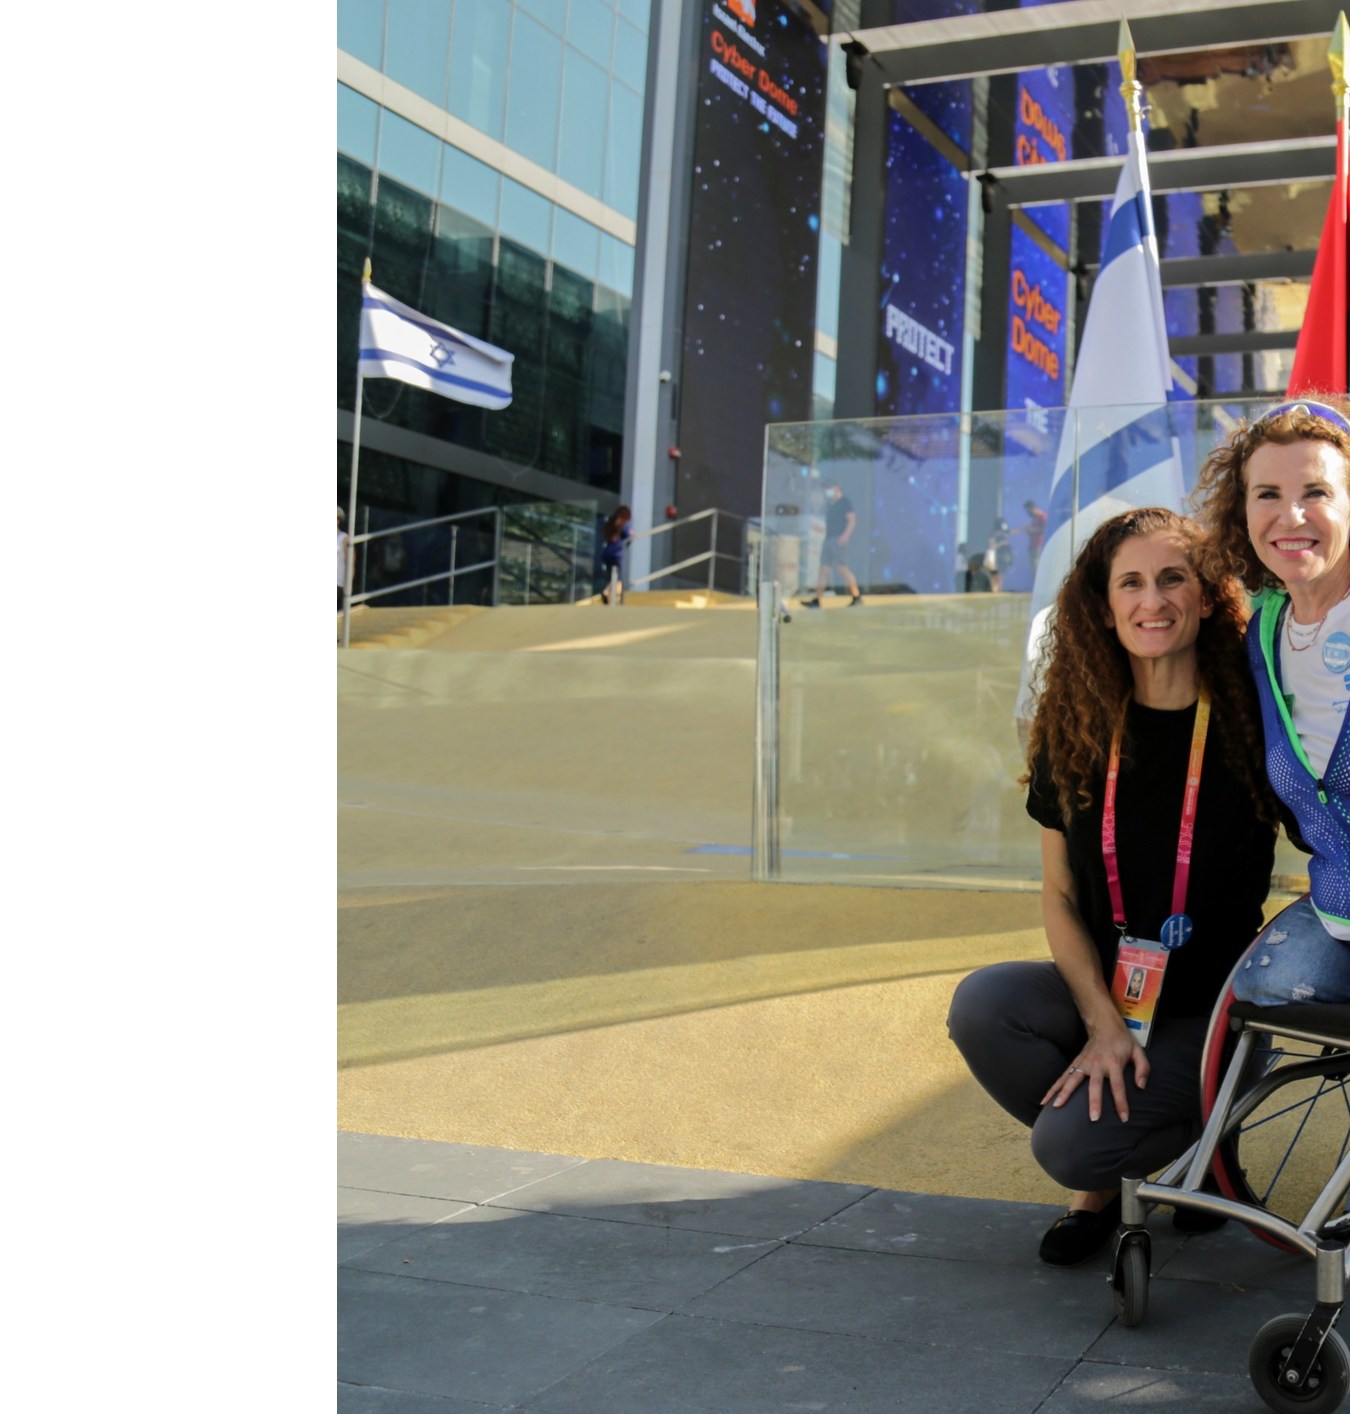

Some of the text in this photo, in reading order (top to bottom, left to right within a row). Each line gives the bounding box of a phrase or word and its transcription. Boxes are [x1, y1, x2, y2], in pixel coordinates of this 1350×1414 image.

[711, 30, 798, 116] Cyber Dome
[1012, 269, 1061, 335] Cyber
[886, 303, 955, 376] PROTECT
[1012, 315, 1060, 380] Dome
